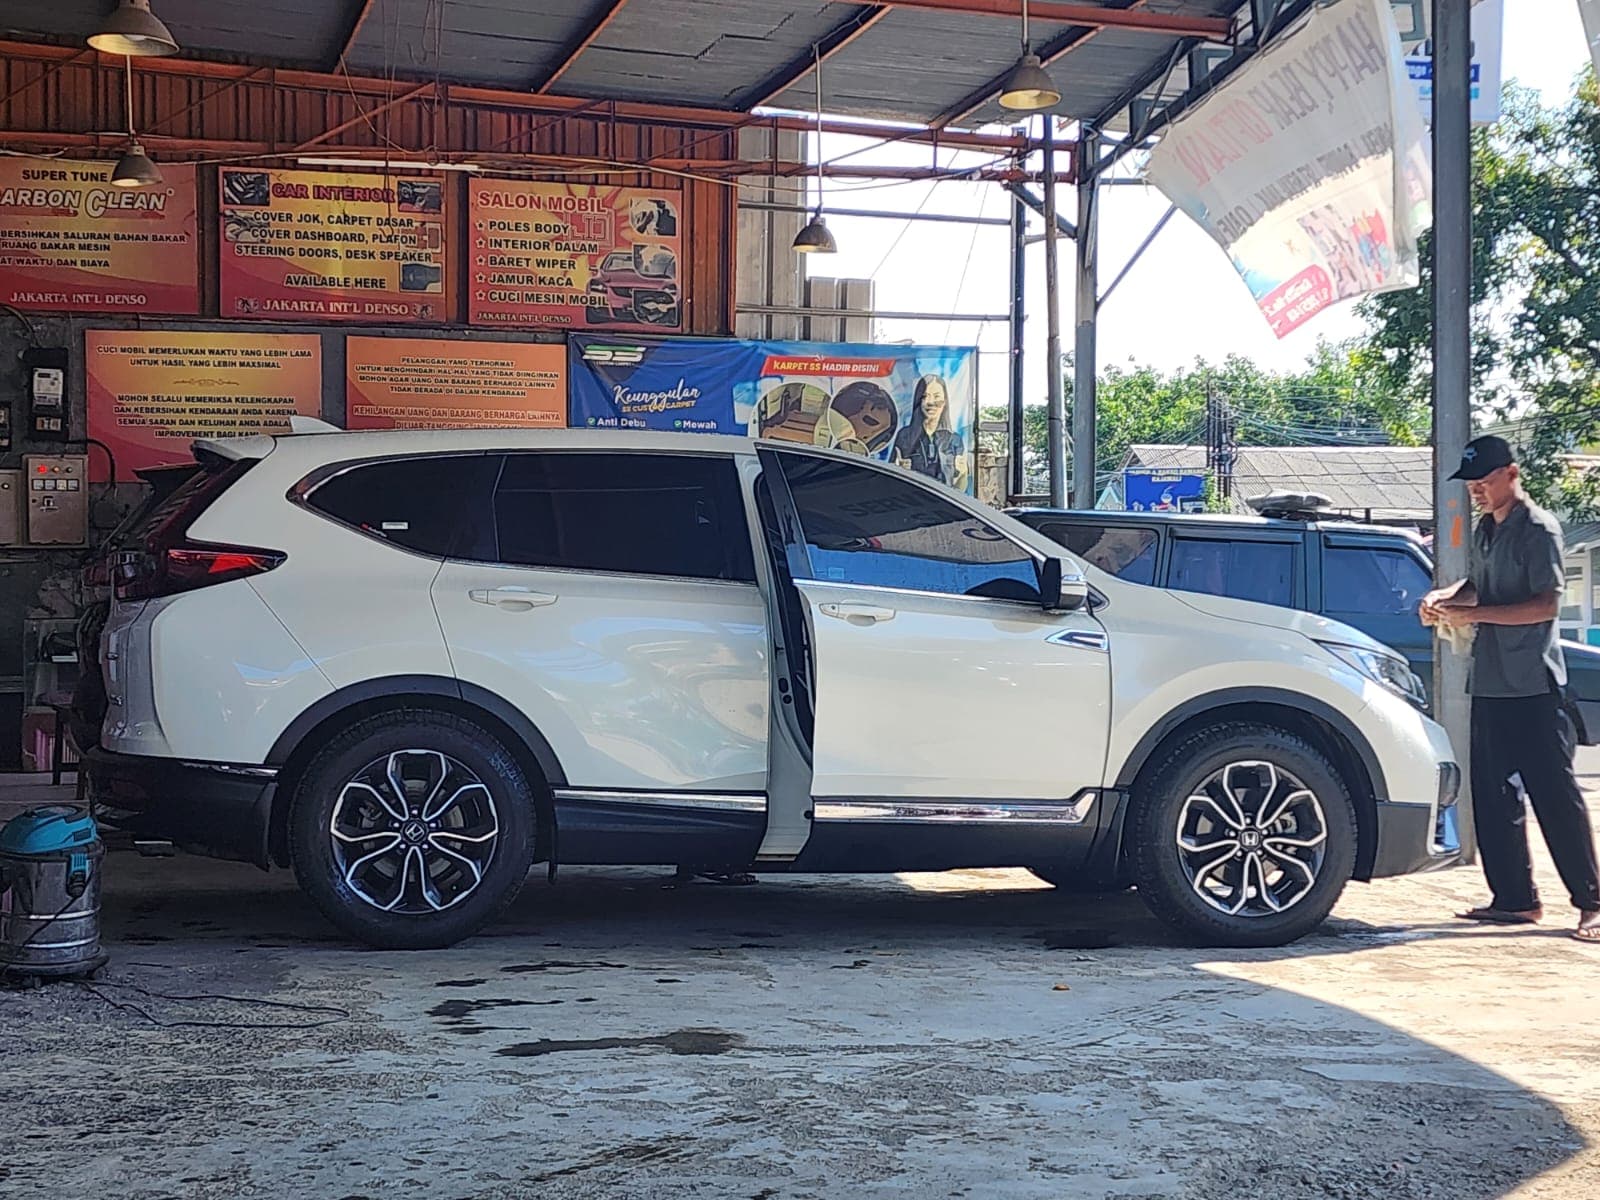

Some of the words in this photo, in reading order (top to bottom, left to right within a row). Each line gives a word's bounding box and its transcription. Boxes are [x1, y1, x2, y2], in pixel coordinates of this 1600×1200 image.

[22, 169, 67, 181] SUPER
[71, 171, 108, 182] TUNE
[271, 182, 309, 199] CAR
[313, 185, 395, 203] INTERIOR
[85, 188, 167, 218] CLEAN
[479, 191, 542, 210] SALON
[548, 195, 607, 213] MOBIL
[253, 211, 293, 223] COVER
[297, 213, 324, 226] JOK,
[327, 214, 372, 227] CARPET
[376, 216, 414, 228] DASAR
[489, 221, 530, 233] POLES
[535, 223, 569, 234] BODY
[63, 231, 111, 241] SALURAN
[114, 233, 149, 242] BAHAN
[152, 234, 186, 243] BAKAR
[251, 229, 291, 240] COVER
[294, 230, 369, 245] DASHBOARD,
[372, 233, 417, 245] PLAFON
[1, 241, 37, 250] RUANG
[40, 242, 75, 251] BAKAR
[79, 243, 111, 251] MESIN
[489, 238, 551, 251] INTERIOR
[555, 241, 599, 254] DALAM
[235, 245, 295, 257] STEERING
[298, 247, 342, 260] DOORS,
[345, 249, 376, 260] DESK
[379, 250, 432, 263] SPEAKER
[15, 258, 53, 266] WAKTU
[56, 258, 77, 267] DAN
[80, 259, 110, 268] BIAYA
[489, 255, 531, 268] BARET
[535, 258, 576, 270] WIPER
[284, 275, 351, 288] AVAILABLE
[354, 276, 386, 289] HERE
[489, 273, 534, 286] JAMUR
[538, 275, 574, 287] KACA
[10, 292, 69, 303] JAKARTA
[105, 294, 147, 305] DENSO
[489, 291, 520, 302] CUCI
[525, 292, 565, 304] MESIN
[569, 294, 609, 306] MOBIL
[262, 300, 326, 313] JAKARTA
[364, 303, 409, 315] DENSO
[477, 312, 517, 322] JAKARTA
[542, 315, 571, 324] DENSO
[120, 346, 146, 354] MOBIL
[148, 347, 206, 355] MEMERLUKAN
[208, 348, 238, 356] WAKTU
[240, 349, 262, 357] YANG
[263, 349, 288, 357] LEBIH
[289, 350, 312, 358] LAMA
[130, 358, 159, 366] UNTUK
[161, 359, 186, 367] HASIL
[189, 359, 210, 367] YANG
[212, 360, 237, 368] LEBIH
[773, 360, 808, 371] KARPET
[810, 362, 821, 371] SS
[822, 362, 850, 372] HADIR
[851, 363, 880, 373] DISINI
[117, 394, 149, 402] MOHON
[151, 395, 182, 403] SELALU
[184, 395, 233, 403] MEMERIKSA
[234, 396, 295, 404] KELENGKAPAN
[613, 378, 700, 412] Keunggulan
[407, 408, 430, 417] UANG
[431, 409, 448, 417] DAN
[597, 417, 618, 427] Anti
[620, 417, 646, 427] Debu
